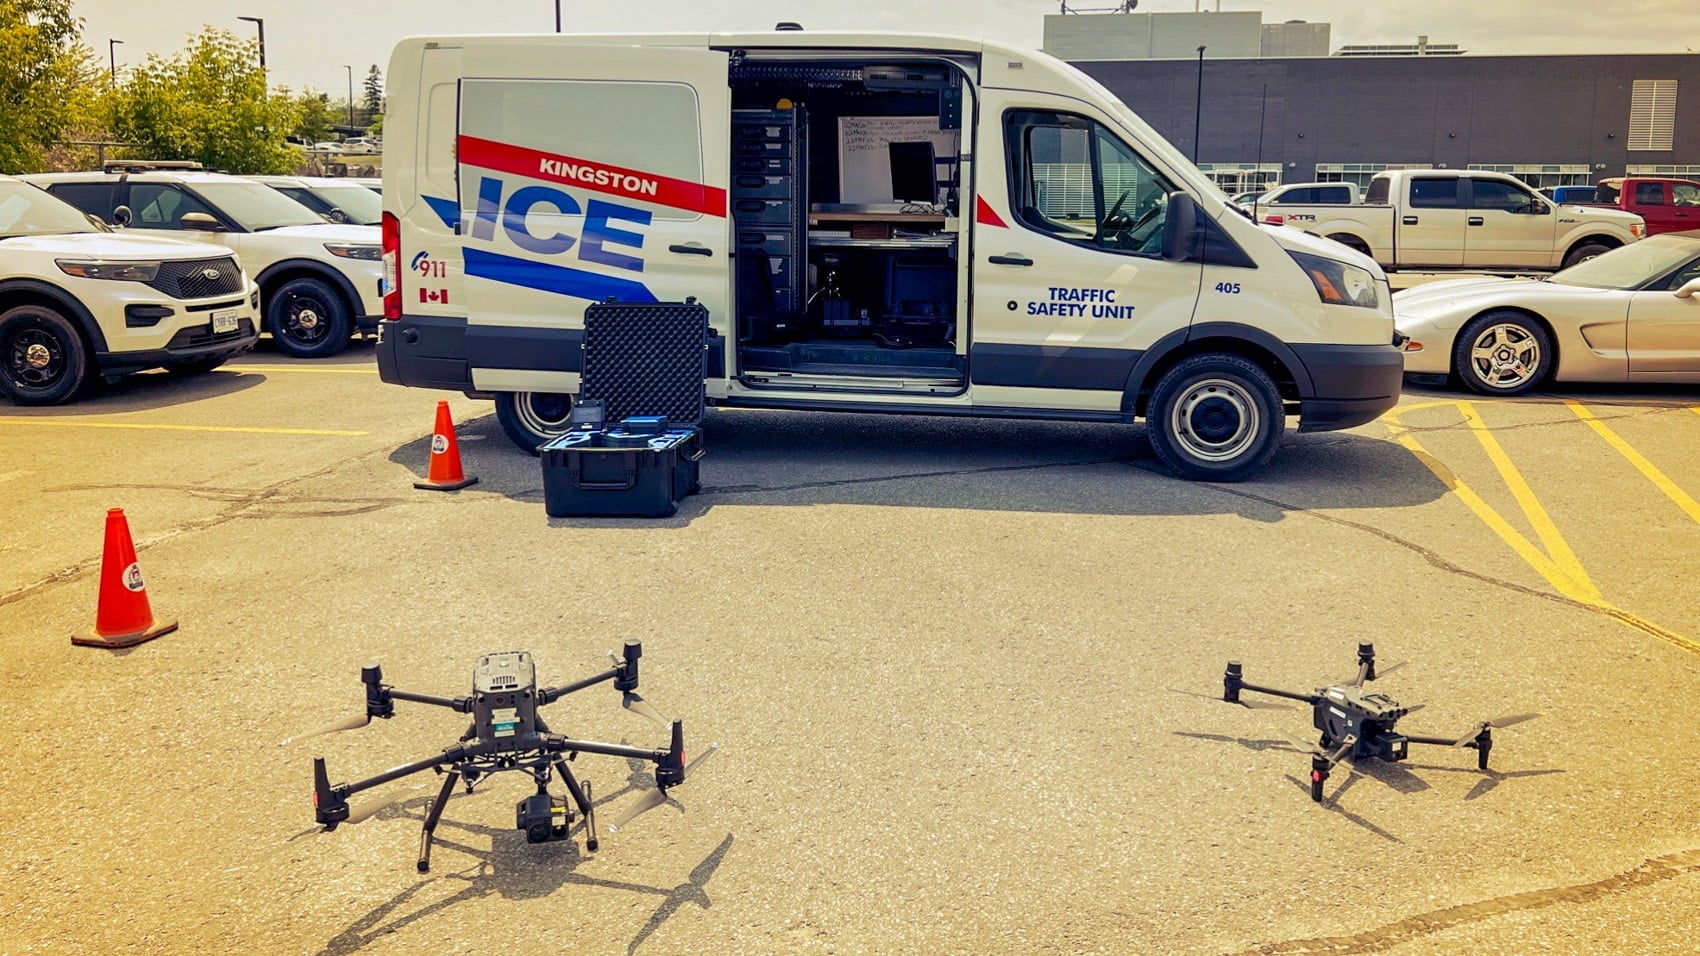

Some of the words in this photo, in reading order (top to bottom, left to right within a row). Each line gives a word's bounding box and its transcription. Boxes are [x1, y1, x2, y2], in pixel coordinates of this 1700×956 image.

[539, 158, 658, 196] KINGSTON
[471, 176, 653, 273] ICE
[419, 260, 446, 278] 911
[1048, 287, 1116, 303] TRAFFIC
[1215, 282, 1241, 294] 405
[1026, 301, 1088, 318] SAFETY
[1091, 304, 1136, 320] UNIT
